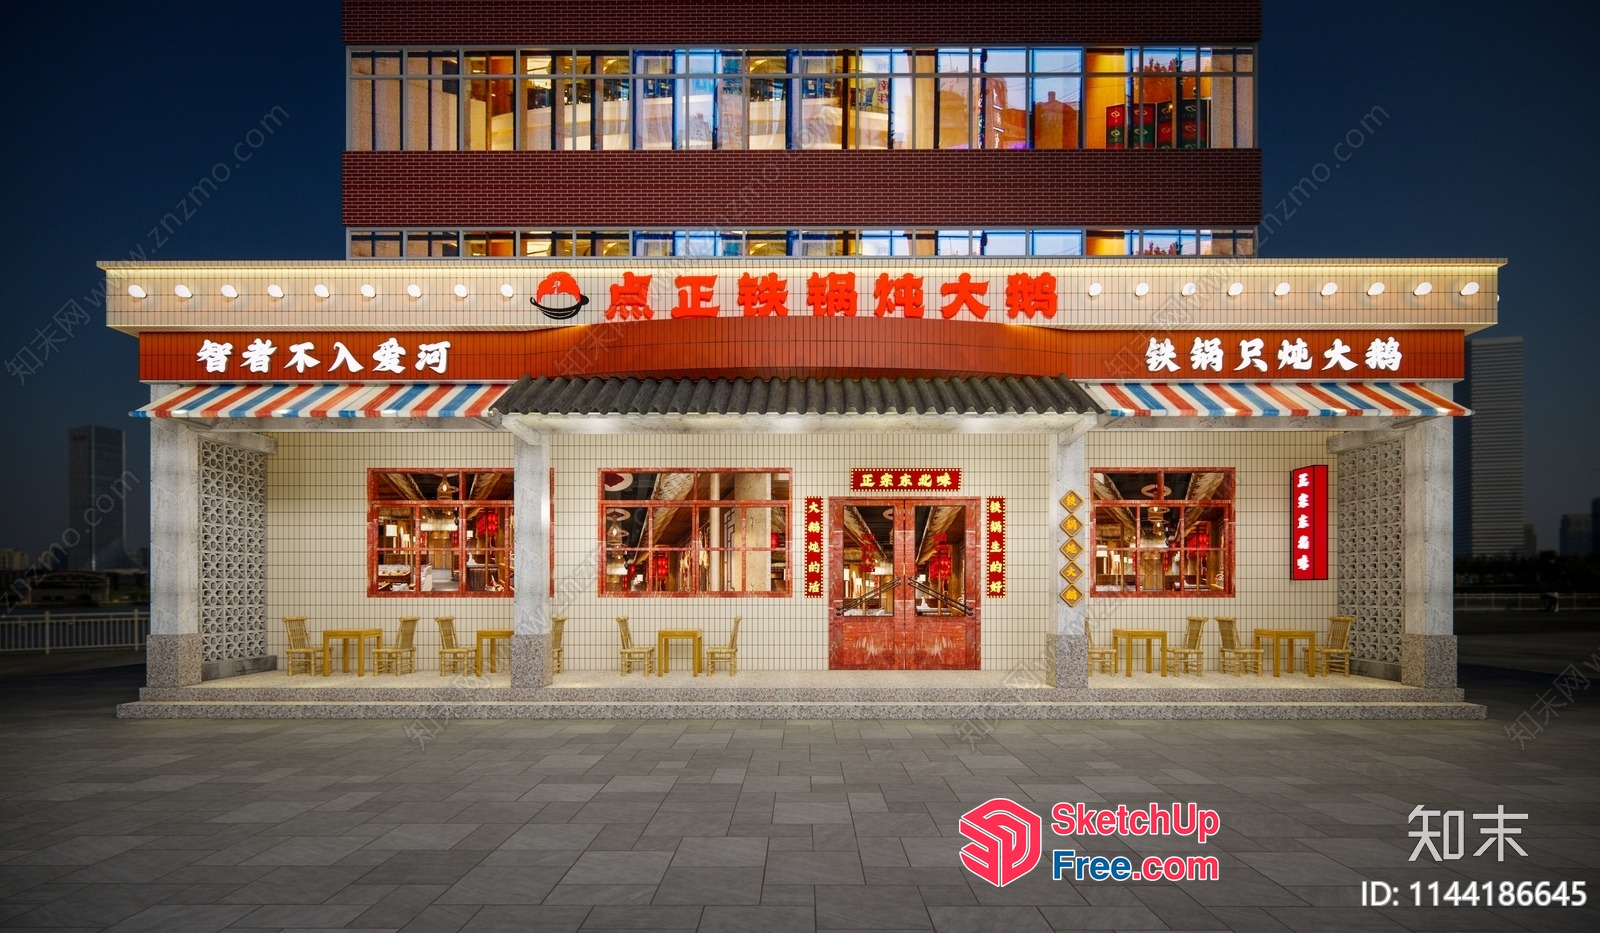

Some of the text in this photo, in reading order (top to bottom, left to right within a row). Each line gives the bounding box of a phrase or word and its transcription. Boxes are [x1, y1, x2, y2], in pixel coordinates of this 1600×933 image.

[606, 271, 1059, 321] 点正铁锅炖大鹅
[196, 337, 452, 376] 智者不入爱河
[1145, 336, 1404, 374] 铁锅只炖大鹅
[859, 472, 953, 487] 正宗东北味
[807, 501, 821, 593] 大鹅炖的活
[989, 500, 1003, 593] 铁锅生的好
[1065, 494, 1079, 600] 铁锅炖大鹅
